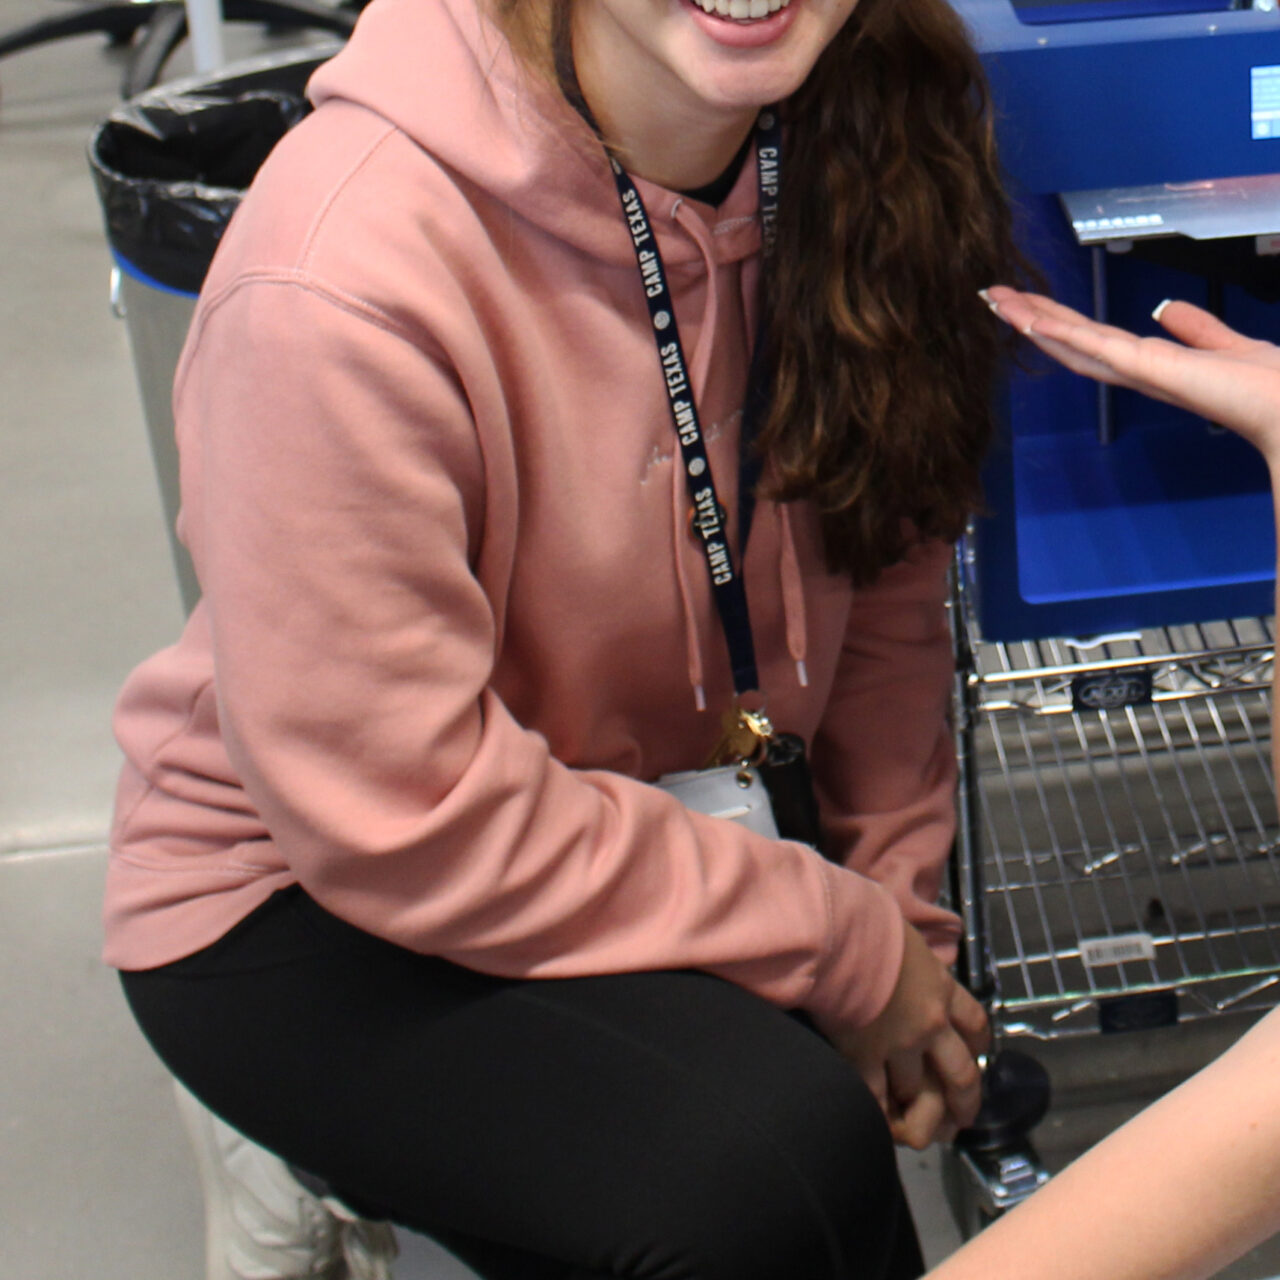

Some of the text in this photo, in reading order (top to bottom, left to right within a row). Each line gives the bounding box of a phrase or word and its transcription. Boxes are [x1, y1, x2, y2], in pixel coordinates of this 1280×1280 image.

[758, 147, 779, 197] CAMP
[622, 188, 664, 298] CAMP TEXAS
[660, 342, 699, 447] CAMP TEXAS
[695, 487, 733, 586] CAMP TEXAS
